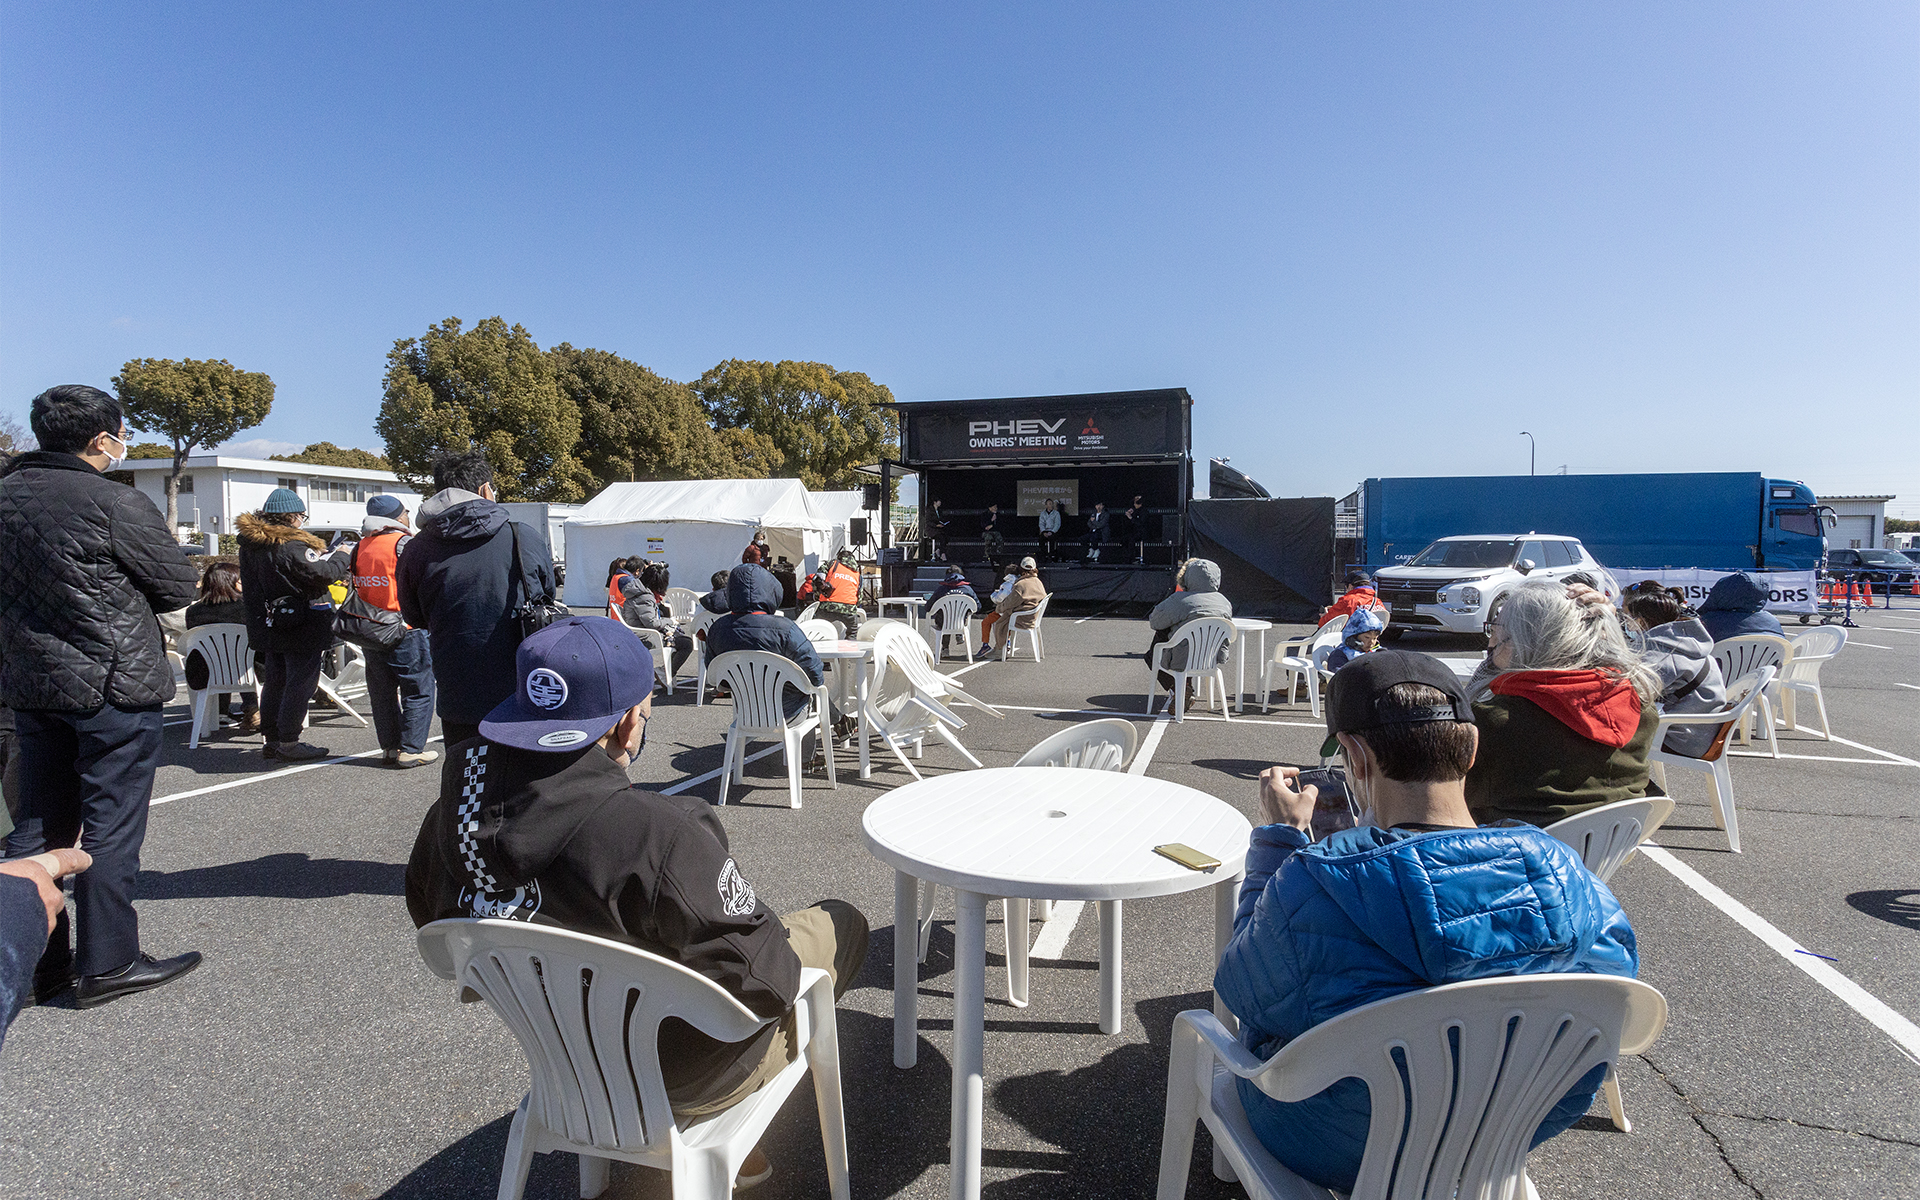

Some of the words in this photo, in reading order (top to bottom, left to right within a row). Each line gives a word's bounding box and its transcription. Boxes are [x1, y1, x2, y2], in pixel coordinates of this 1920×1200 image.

[969, 418, 1066, 436] PHEV
[969, 437, 1017, 448] OWNERS'
[1019, 435, 1067, 446] MEETING
[355, 575, 389, 587] PRESS
